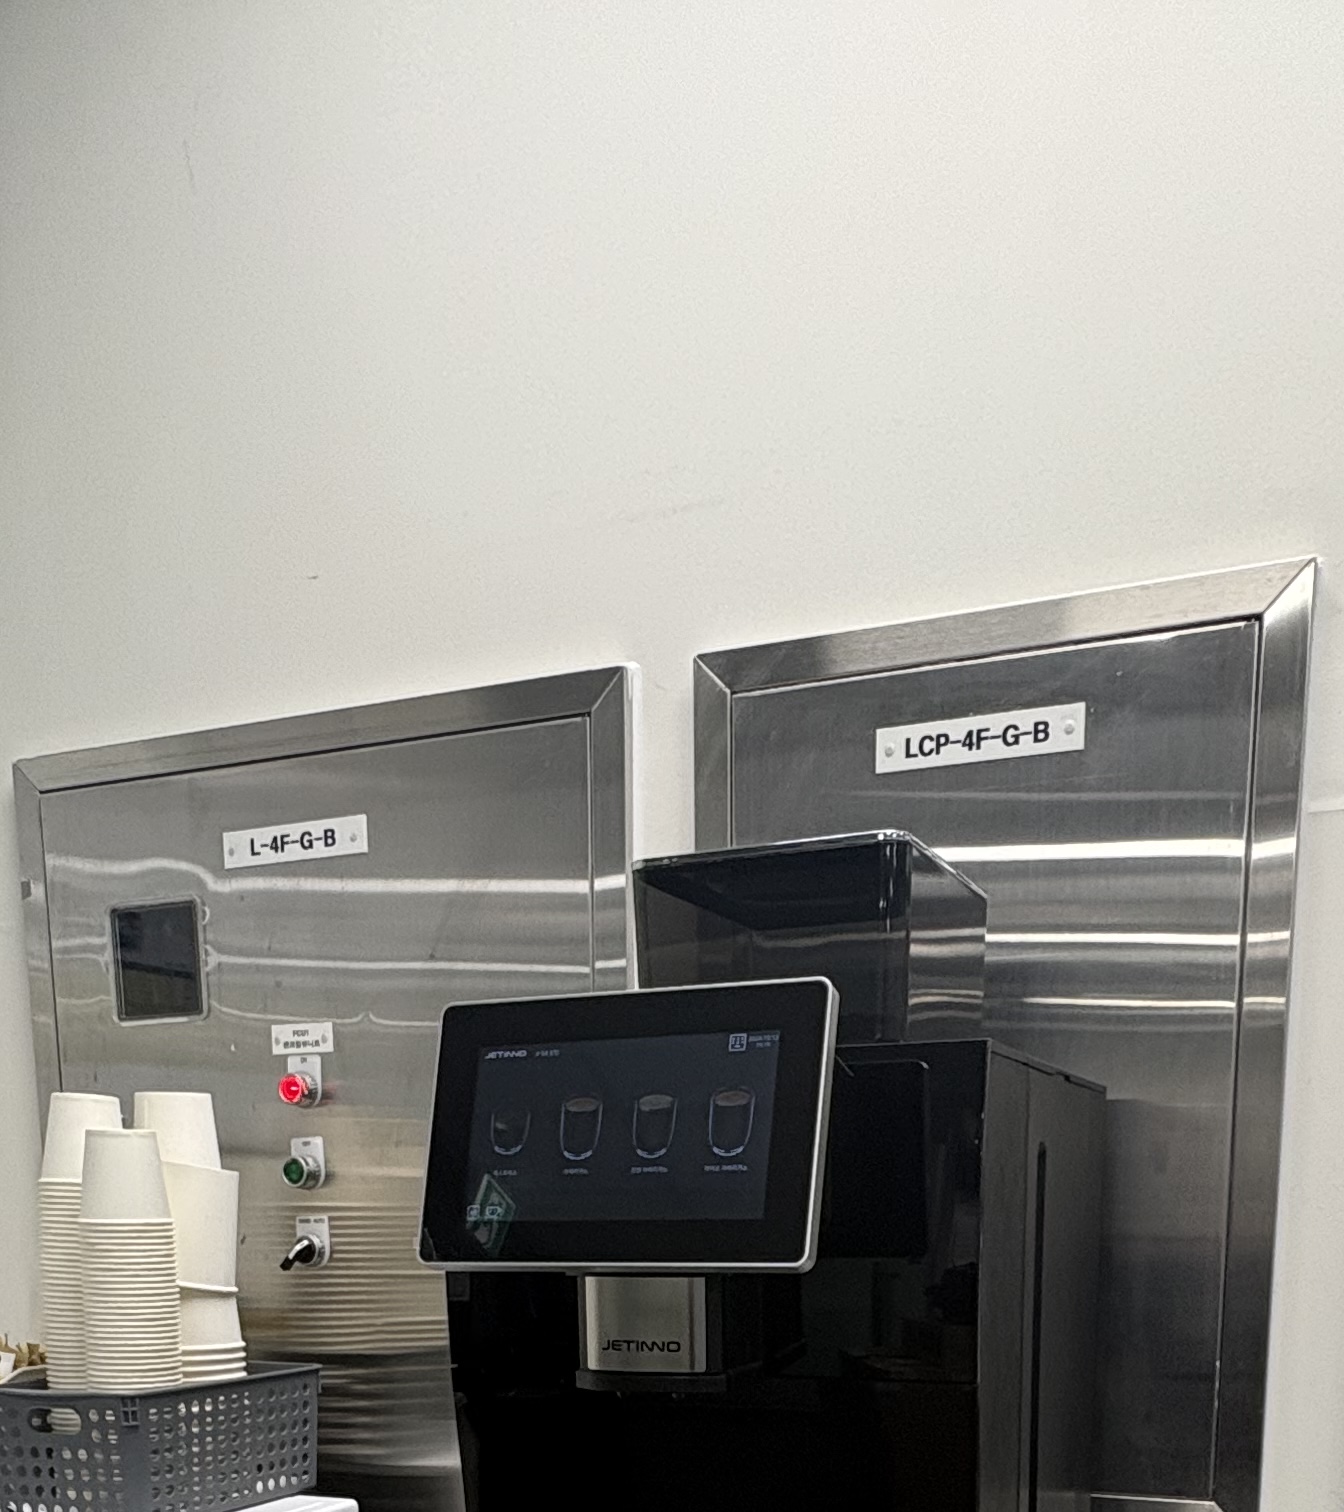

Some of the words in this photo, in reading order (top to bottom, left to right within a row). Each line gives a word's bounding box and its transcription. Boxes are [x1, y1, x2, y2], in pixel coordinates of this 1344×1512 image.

[905, 720, 1051, 759] LCP-4F-G-B
[250, 828, 337, 857] L-4F-G-B
[601, 1339, 682, 1353] JETINNO
